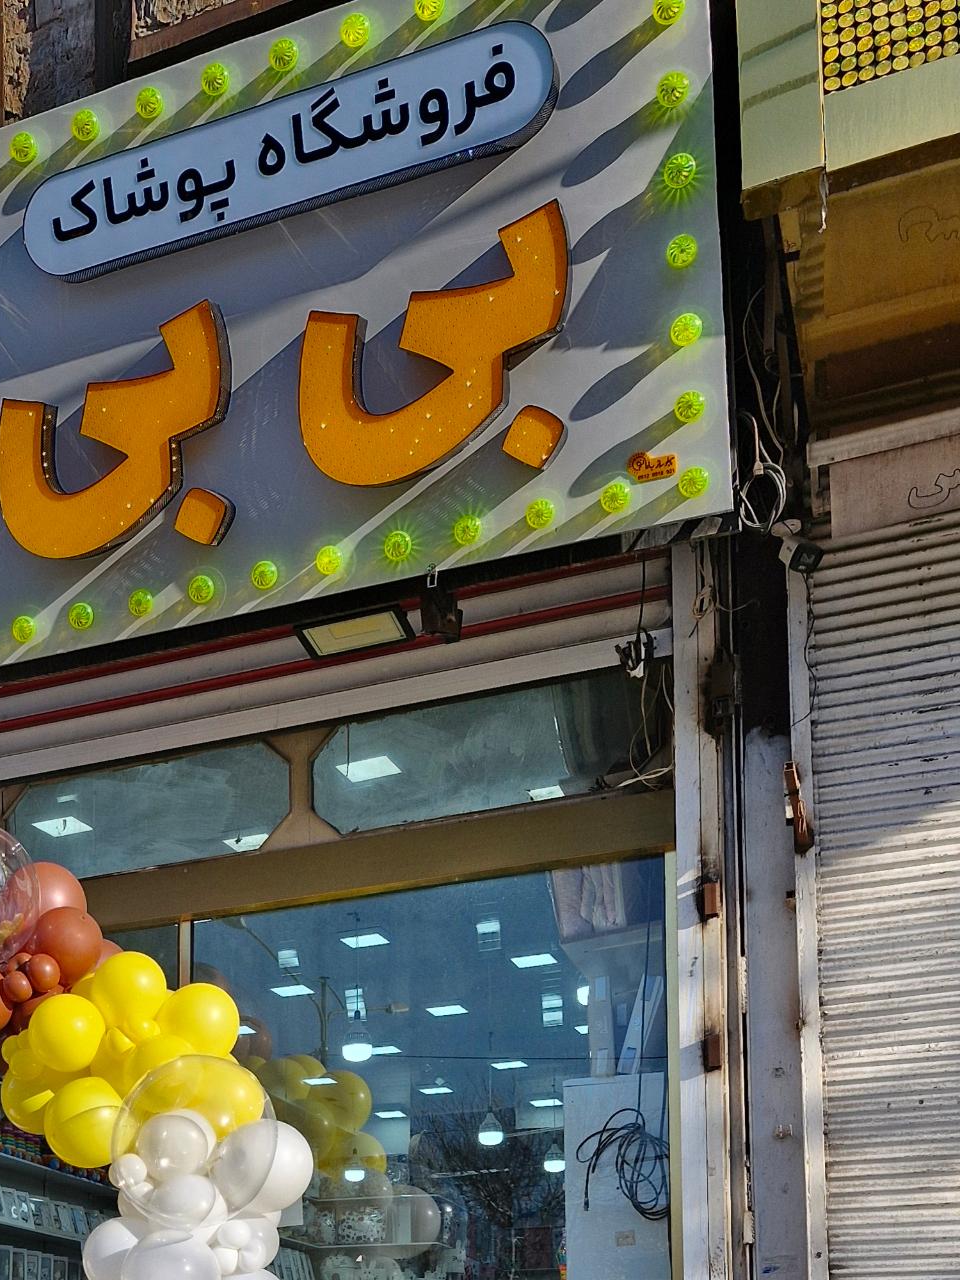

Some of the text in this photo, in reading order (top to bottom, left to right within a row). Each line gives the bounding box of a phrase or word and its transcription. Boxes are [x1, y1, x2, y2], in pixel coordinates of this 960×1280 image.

[52, 42, 515, 243] فروشگاه پوشاک
[298, 198, 571, 488] بی
